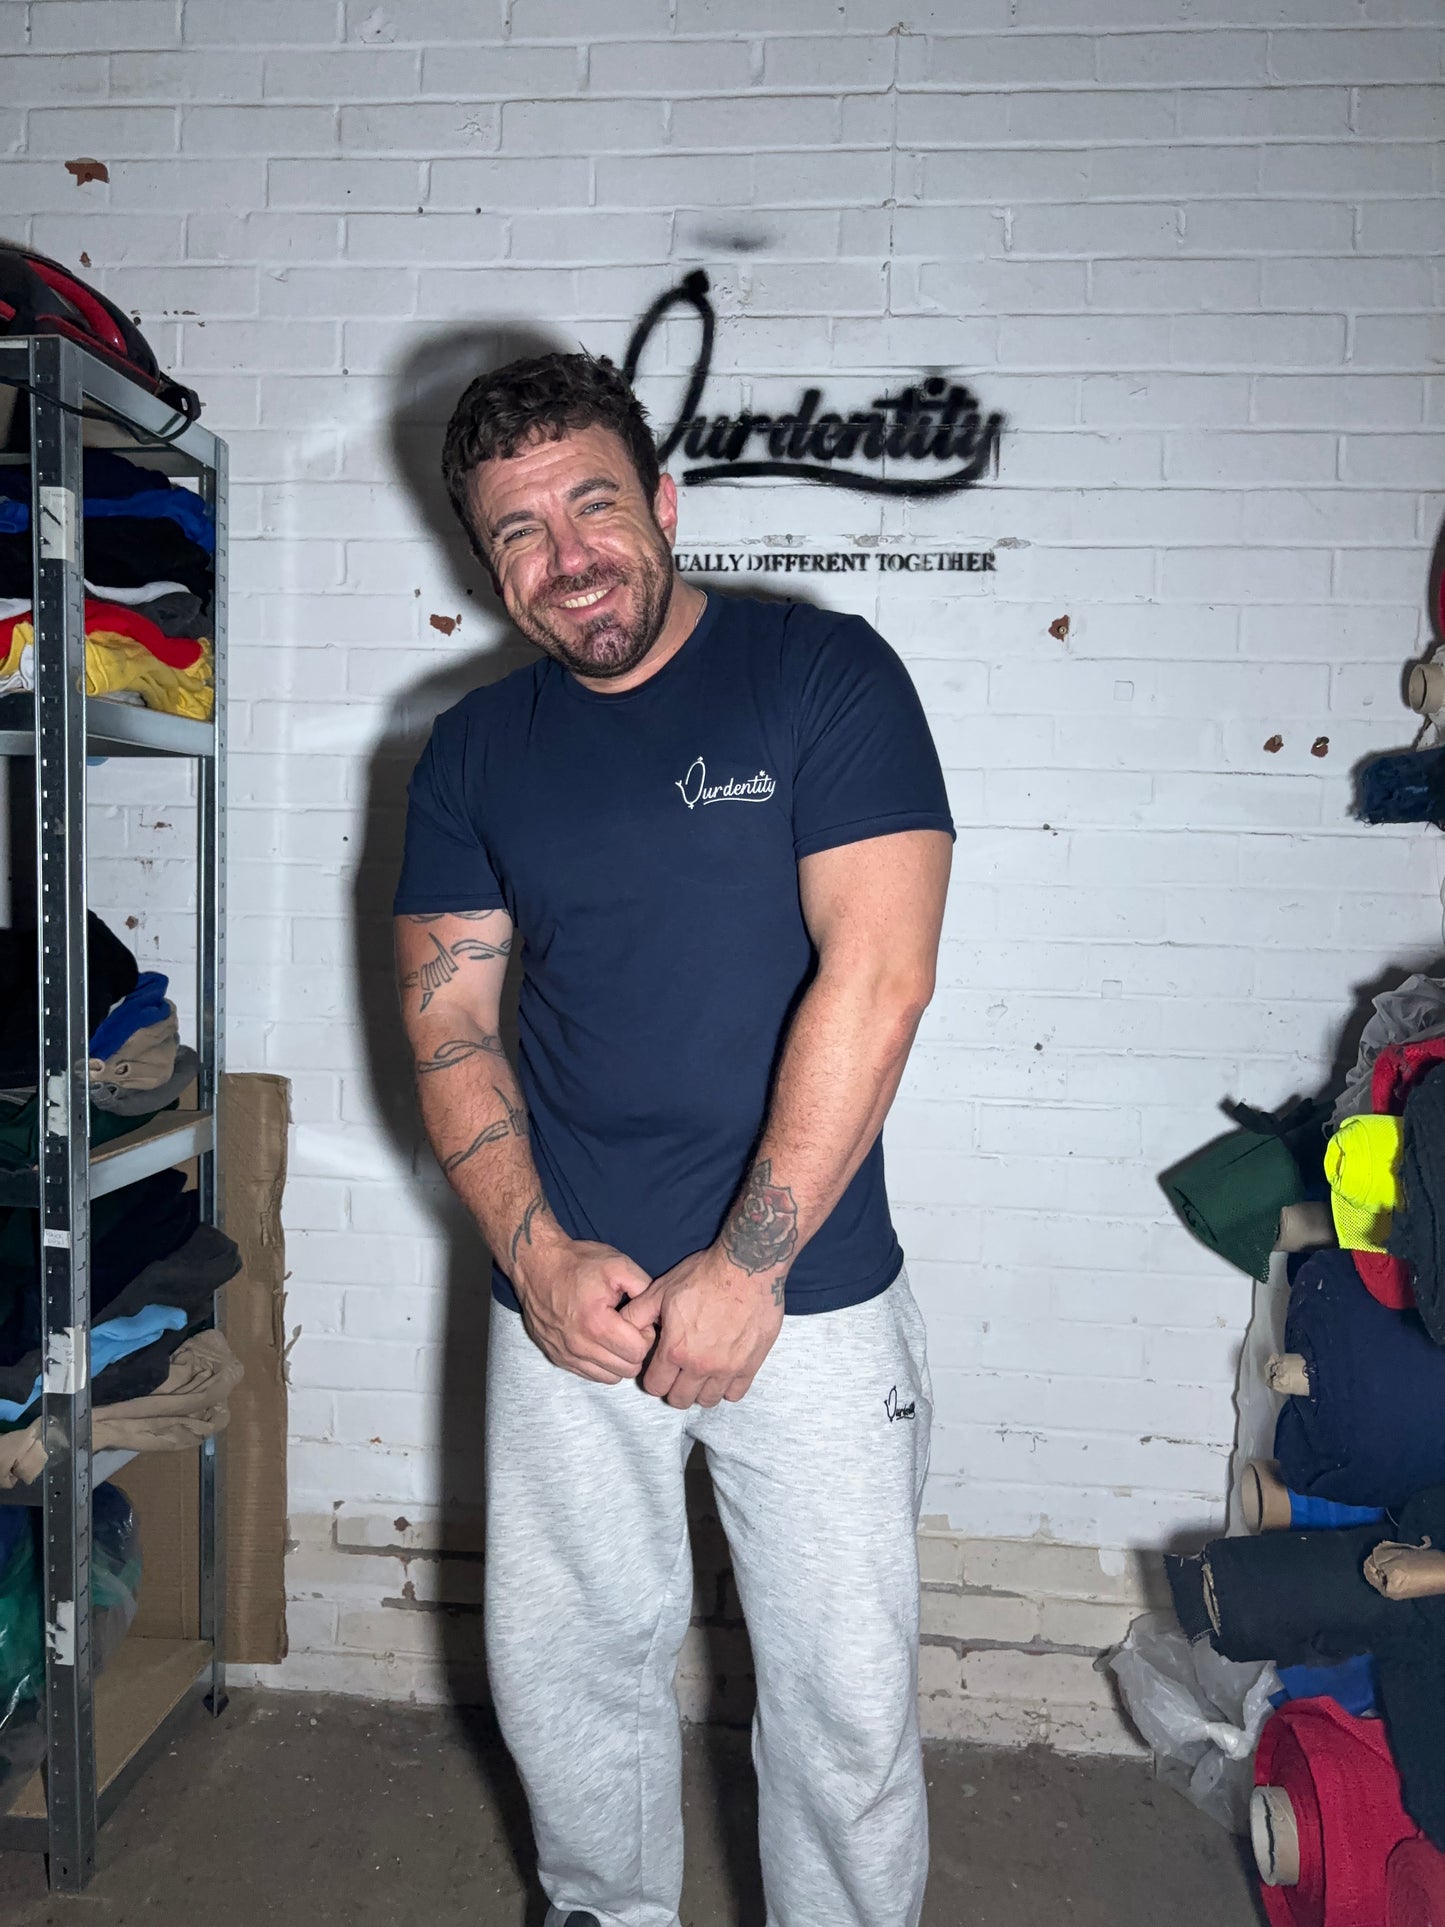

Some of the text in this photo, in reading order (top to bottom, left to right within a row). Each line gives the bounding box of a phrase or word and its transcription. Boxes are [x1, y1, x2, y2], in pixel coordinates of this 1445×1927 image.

[674, 551, 997, 572] UALLY DIFFERENT TOGETHER
